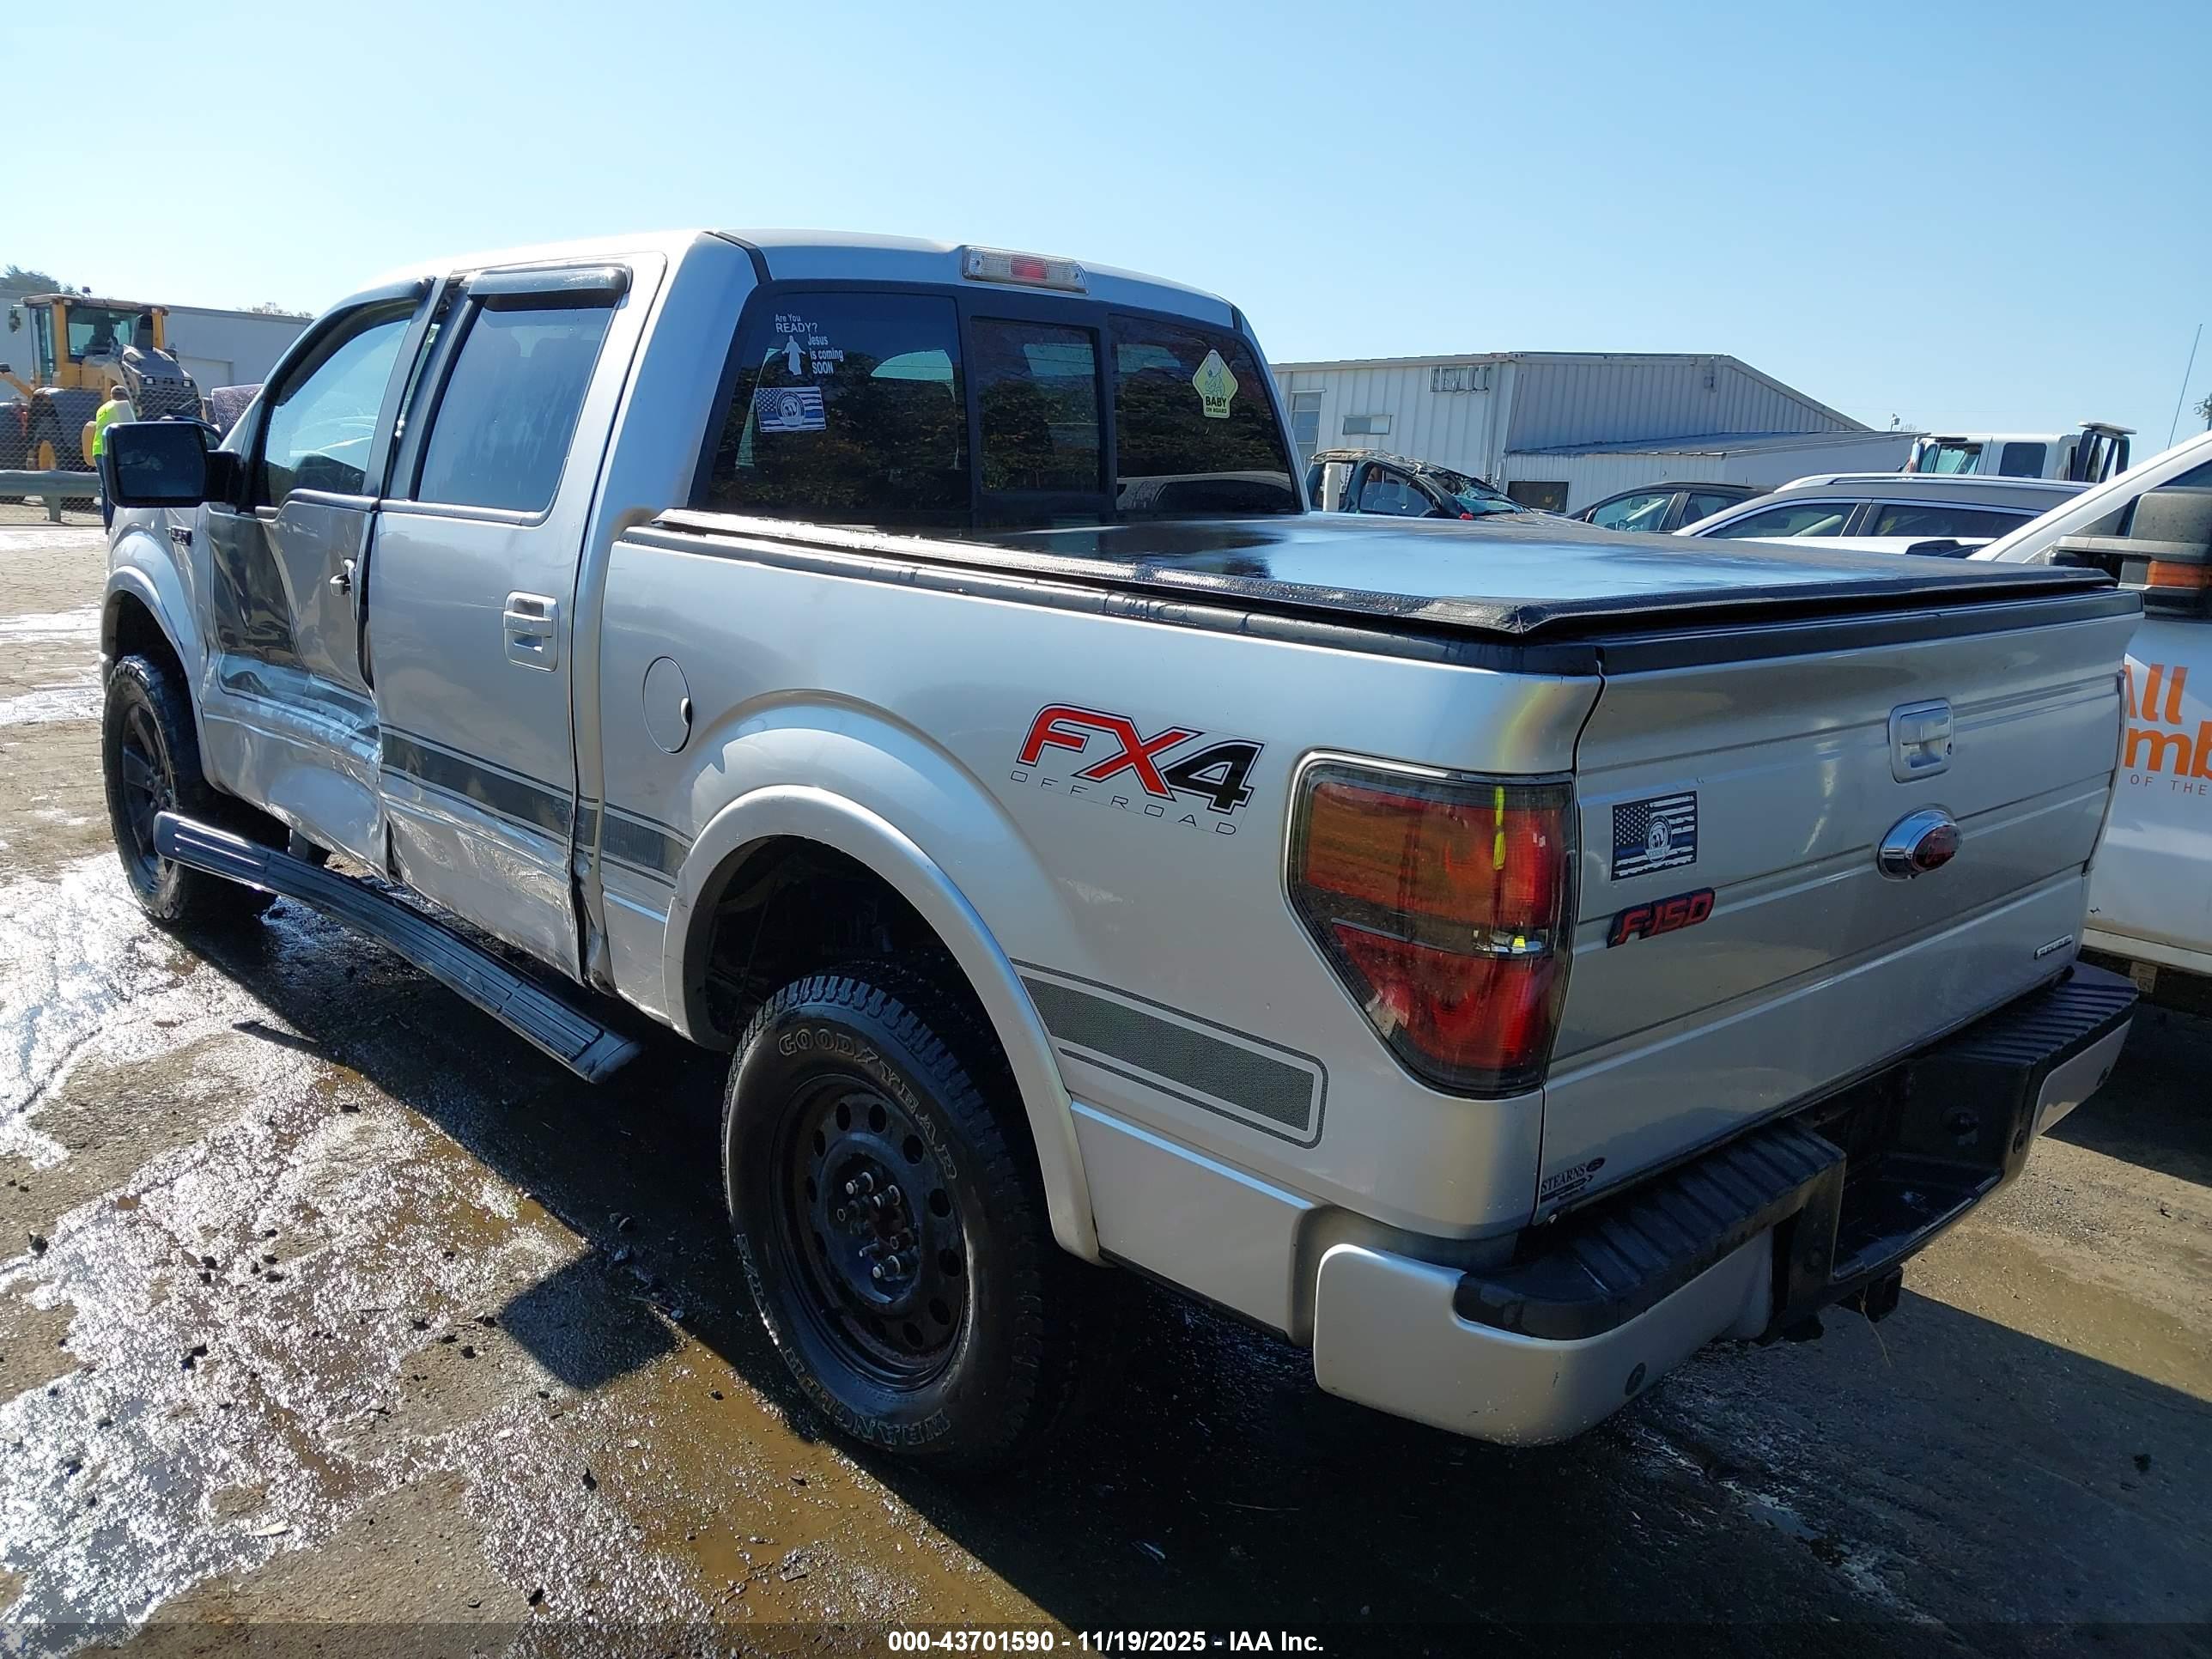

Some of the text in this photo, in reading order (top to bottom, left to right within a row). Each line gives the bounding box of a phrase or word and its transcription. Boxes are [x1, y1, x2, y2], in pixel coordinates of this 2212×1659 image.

[787, 313, 801, 322] You
[775, 322, 818, 333] READY?
[808, 333, 829, 345] Jesus
[809, 347, 844, 362] is coming
[811, 361, 834, 374] SOON
[1206, 396, 1227, 407] BABY
[1016, 702, 1265, 816] FX4
[2130, 774, 2209, 796] OF THE
[778, 1028, 957, 1181] GOODYEAR
[1540, 1165, 1585, 1193] STEARNS
